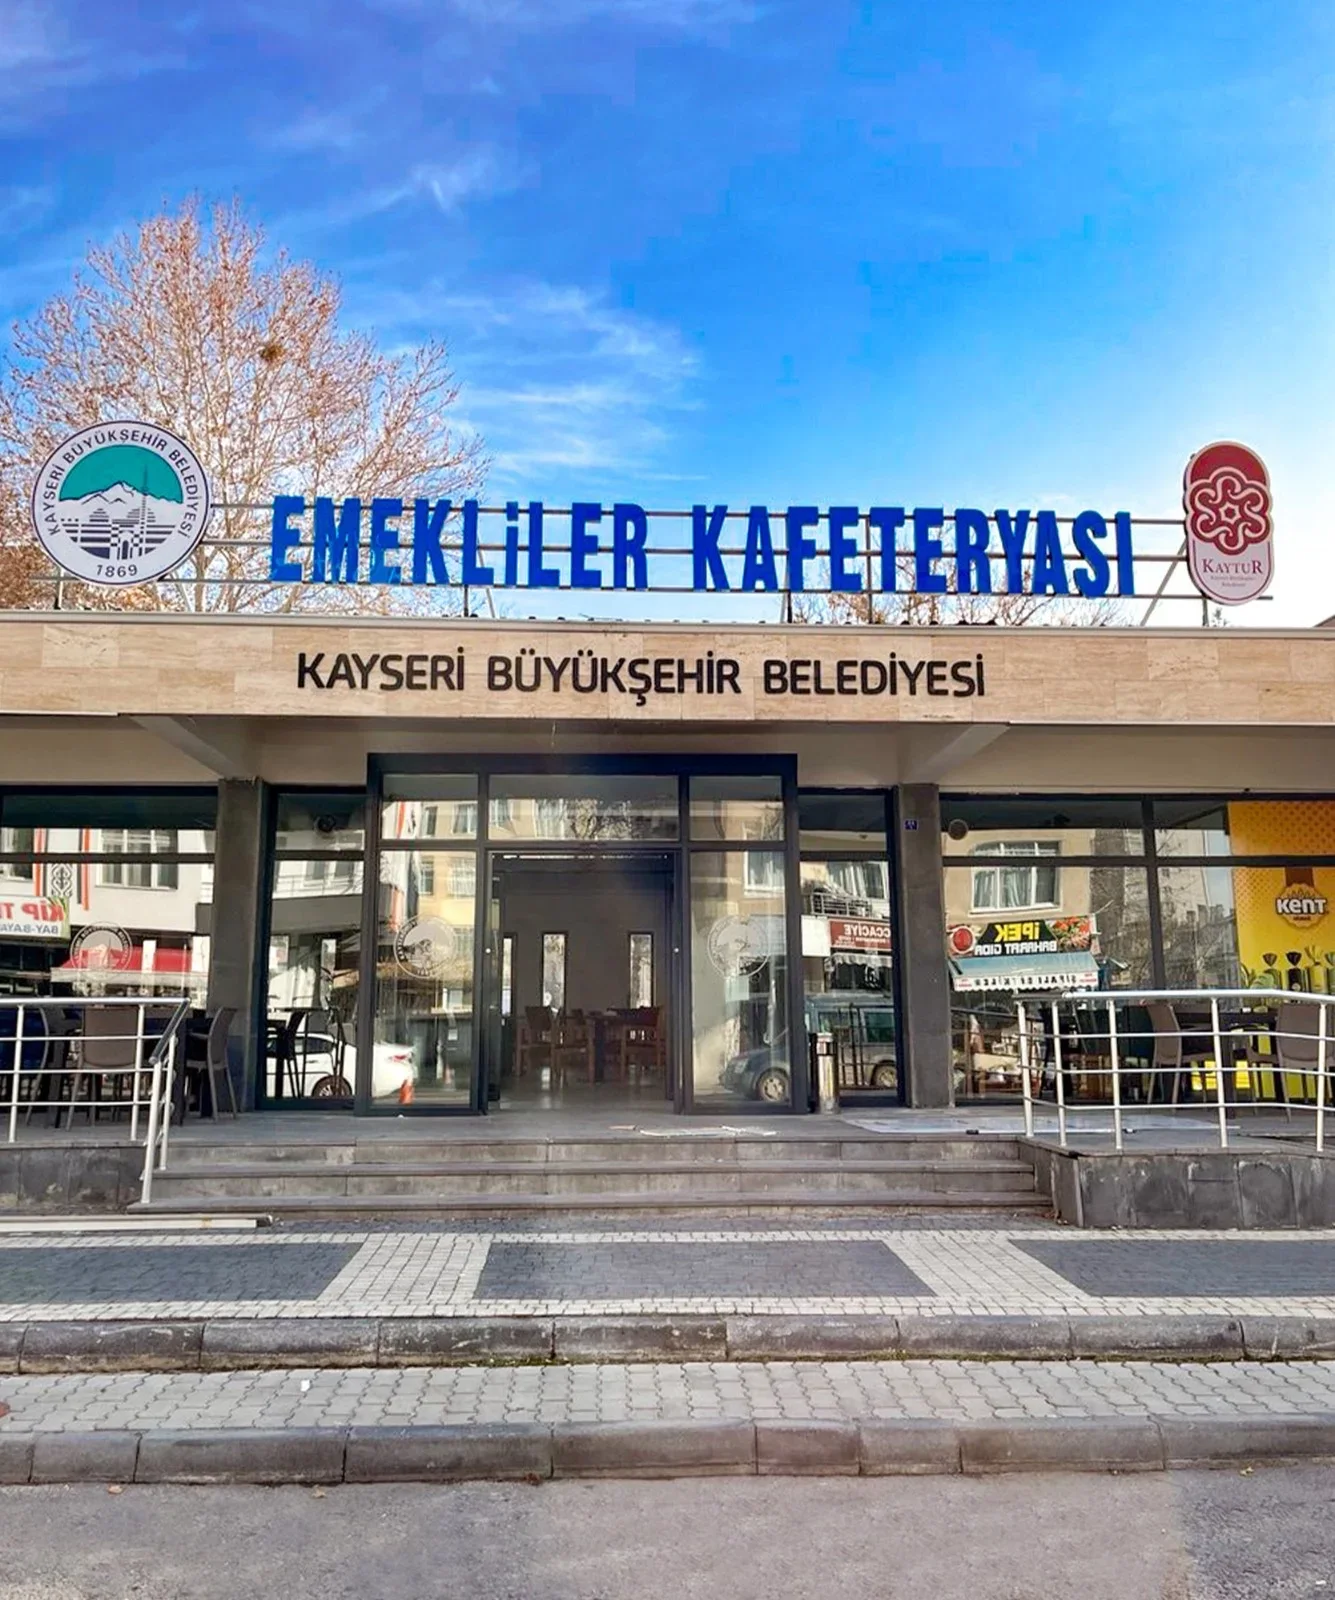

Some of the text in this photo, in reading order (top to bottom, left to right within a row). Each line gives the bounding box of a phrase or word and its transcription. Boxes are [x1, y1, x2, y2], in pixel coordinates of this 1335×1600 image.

[43, 428, 200, 539] KAYSERİ BÜYÜKŞEHİR BELEDİYESİ
[96, 564, 138, 577] 1869
[692, 504, 1135, 599] KAFETERYASI
[297, 646, 985, 707] KAYSERİ BÜYÜKŞEHİR BELEDİYESİ
